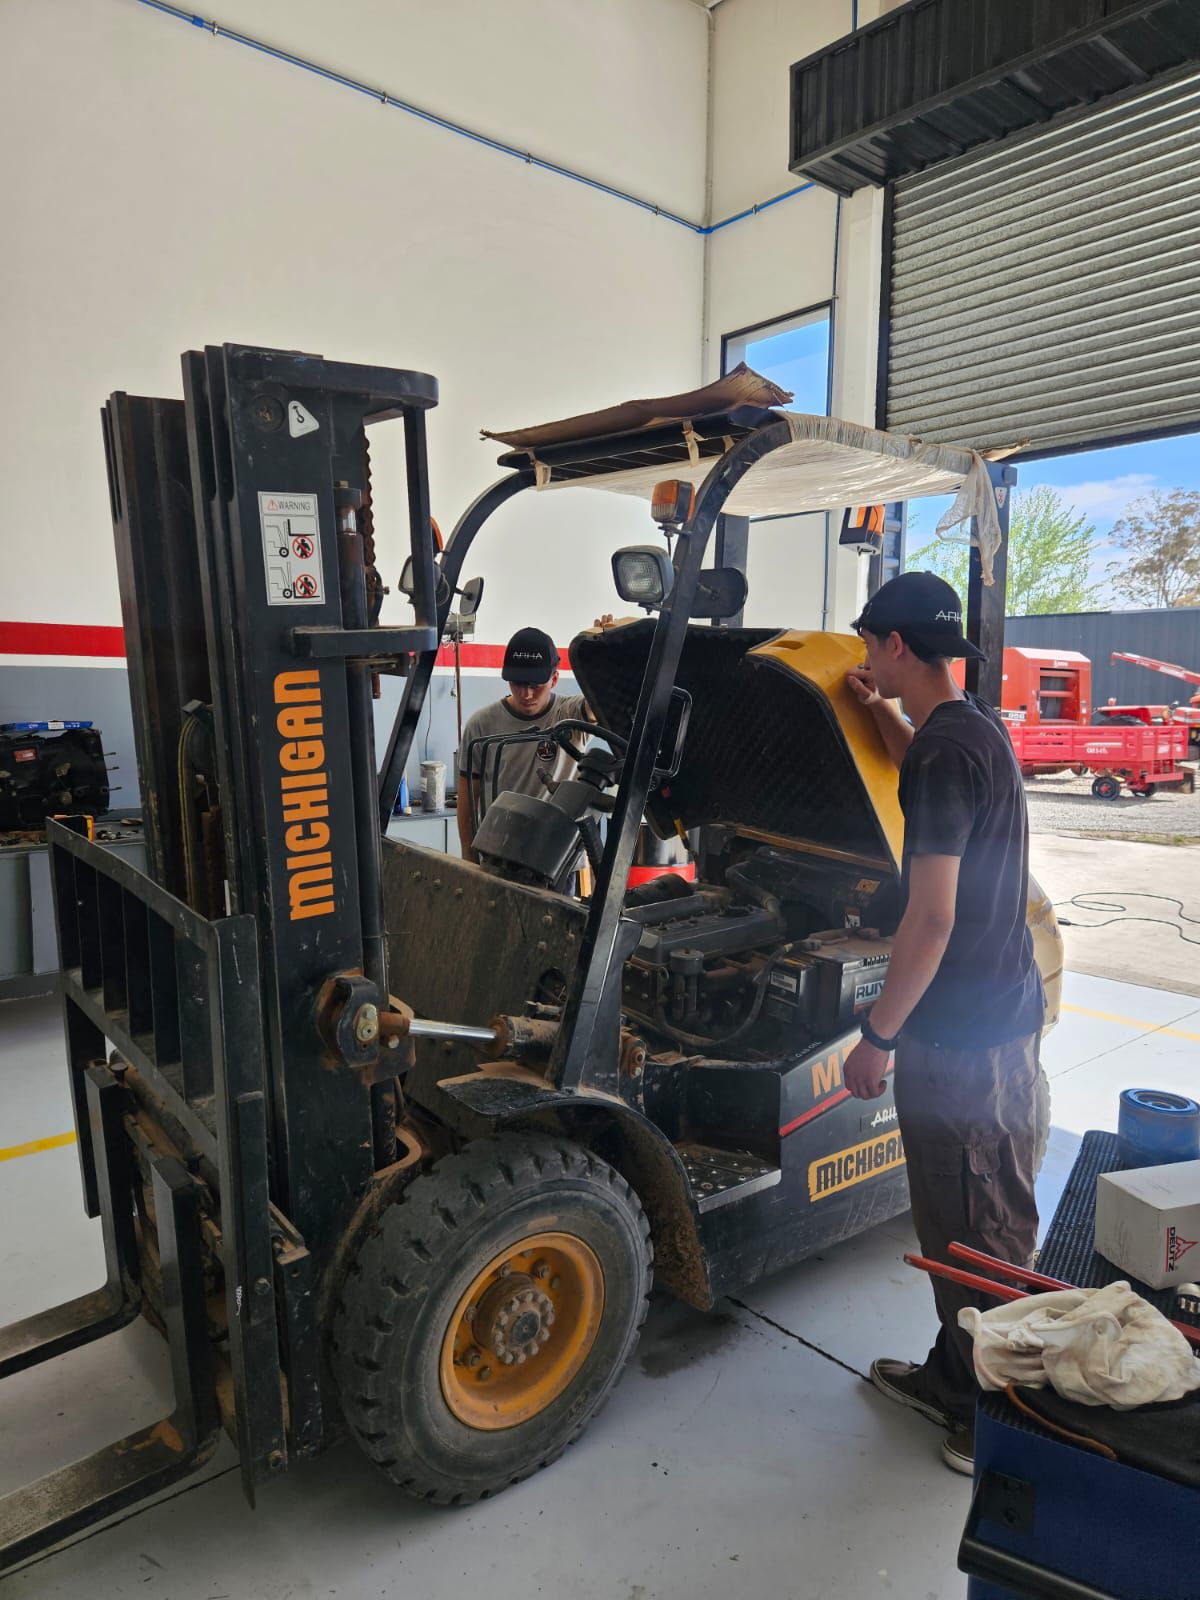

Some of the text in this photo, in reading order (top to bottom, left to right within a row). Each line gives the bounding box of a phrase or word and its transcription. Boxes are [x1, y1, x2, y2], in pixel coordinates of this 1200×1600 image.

[279, 500, 311, 511] WARNING
[935, 609, 963, 623] ARH
[273, 669, 335, 921] MICHIGAN
[870, 1105, 898, 1128] ARH
[1168, 1226, 1176, 1273] DEUTZ
